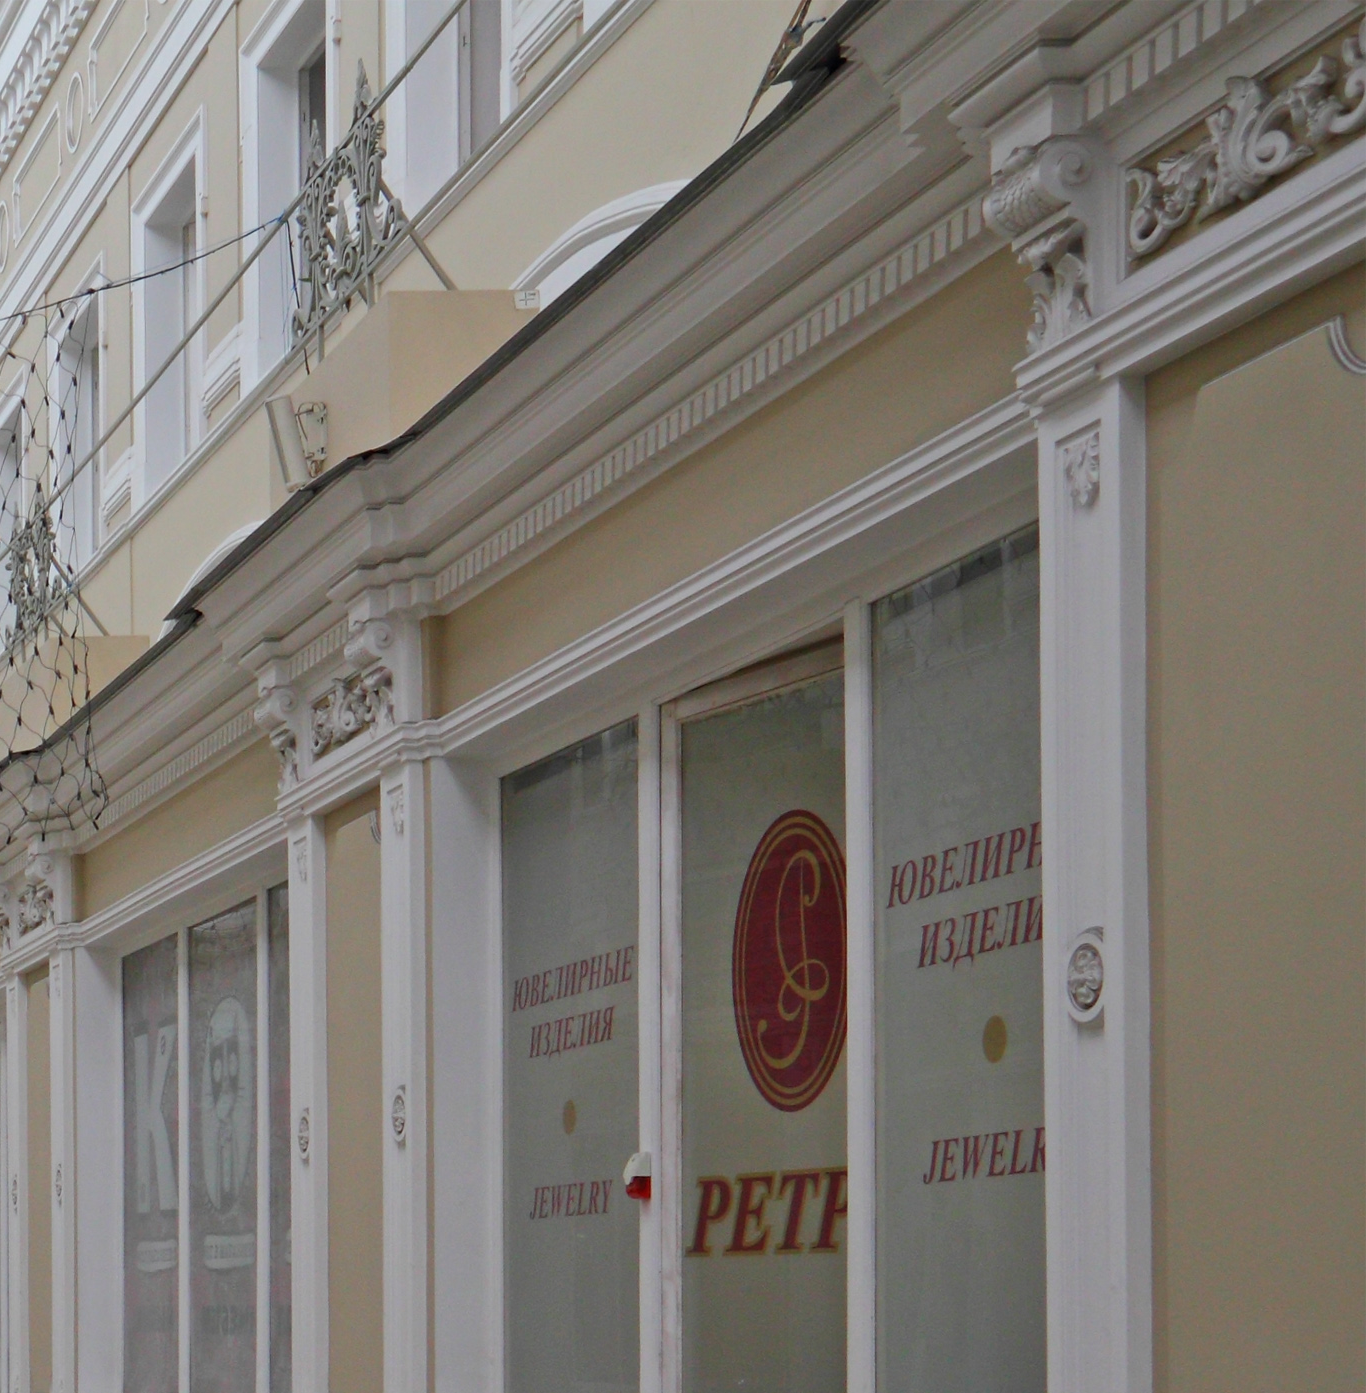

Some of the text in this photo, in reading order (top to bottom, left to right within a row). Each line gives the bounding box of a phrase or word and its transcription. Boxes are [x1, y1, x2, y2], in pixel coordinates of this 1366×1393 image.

[512, 945, 634, 1013] ЮВЕЛИРНЫЕ
[529, 1005, 615, 1058] ИЗДЕЛИЯ
[529, 1179, 613, 1220] JEWELRY
